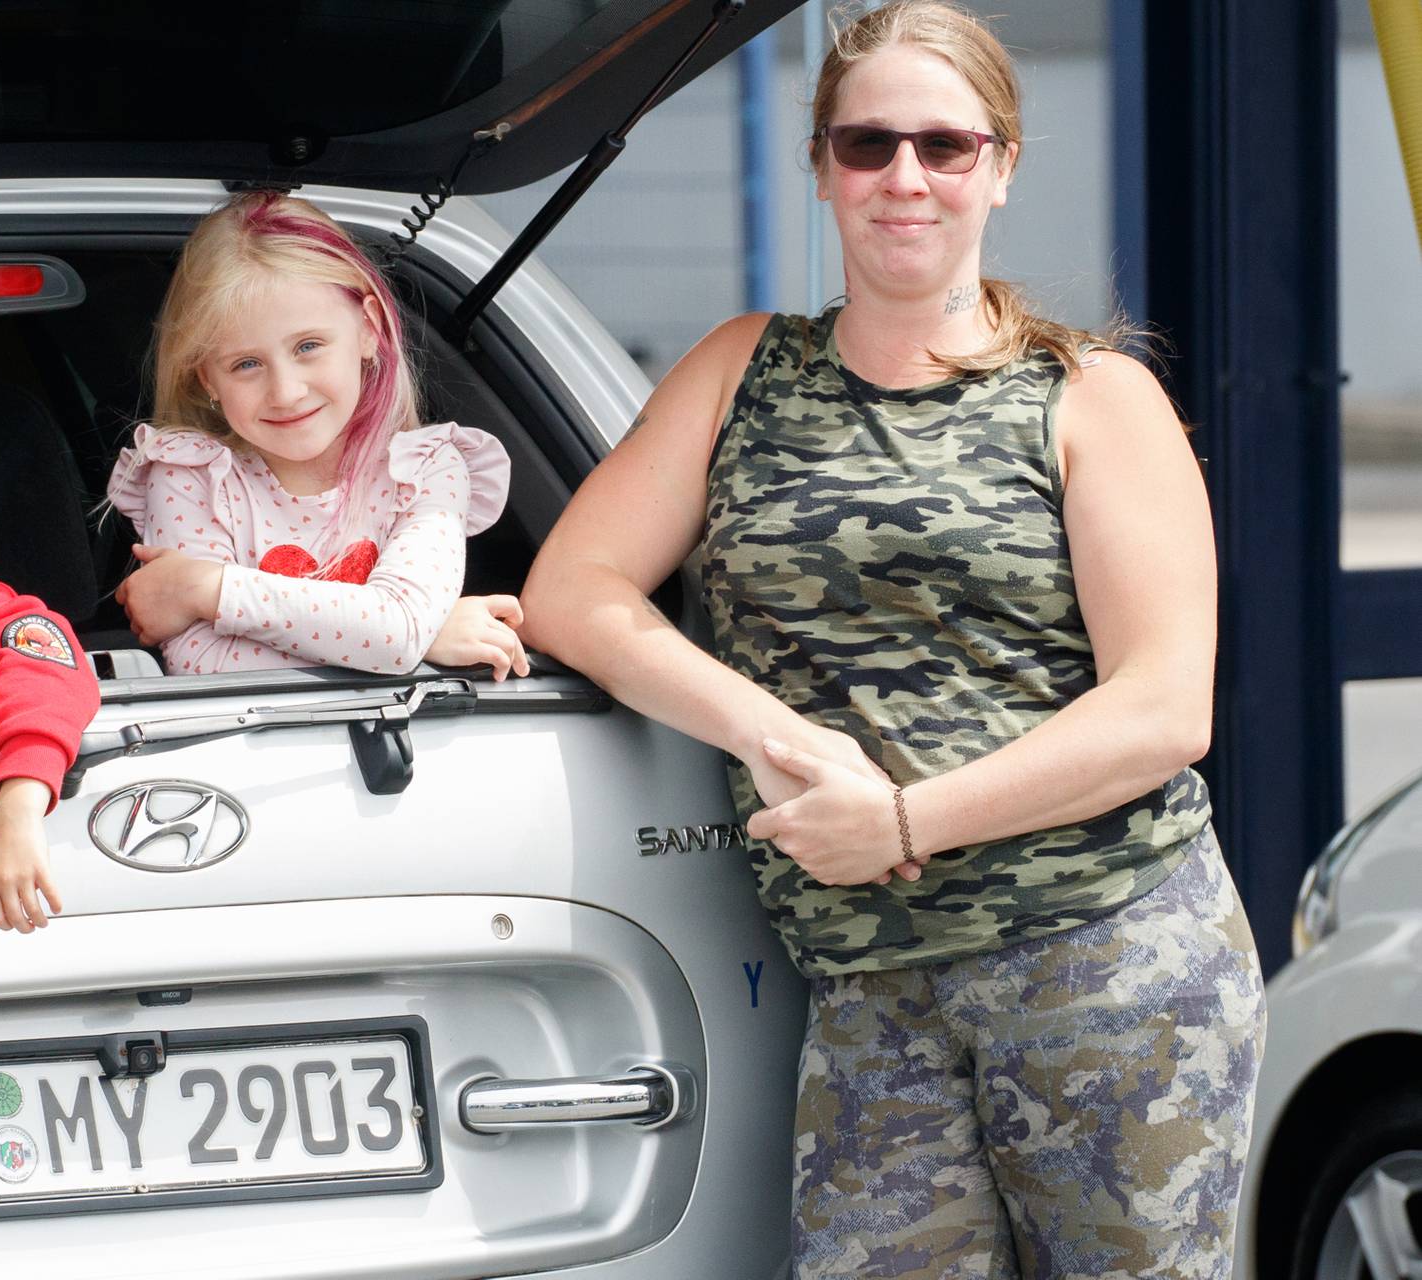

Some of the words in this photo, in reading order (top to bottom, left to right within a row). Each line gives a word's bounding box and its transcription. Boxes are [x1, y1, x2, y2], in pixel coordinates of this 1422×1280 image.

[635, 823, 746, 857] SANTA
[741, 960, 764, 1008] Y
[37, 1076, 148, 1174] MY
[179, 1056, 404, 1166] 2903
